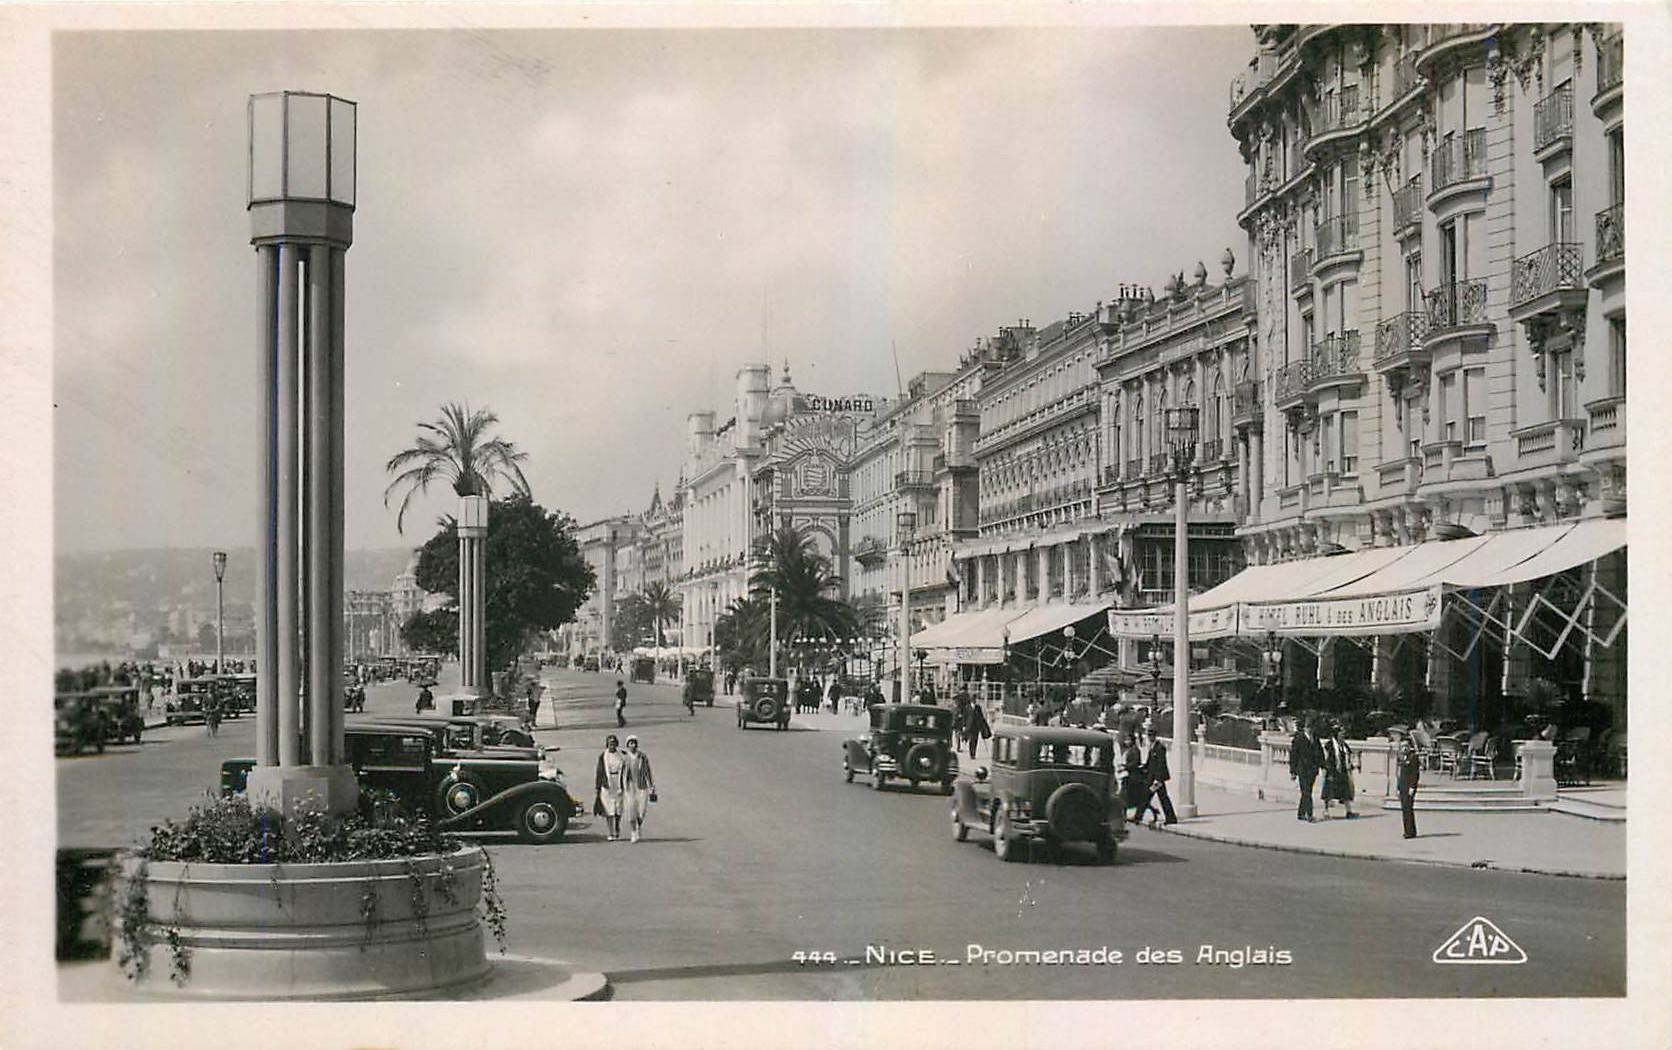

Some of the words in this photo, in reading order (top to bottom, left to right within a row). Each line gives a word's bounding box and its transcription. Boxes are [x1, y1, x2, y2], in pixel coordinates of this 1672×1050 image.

[812, 399, 873, 413] CUNARD
[1295, 604, 1321, 625] RUHL
[1359, 597, 1412, 623] ANGLAIS
